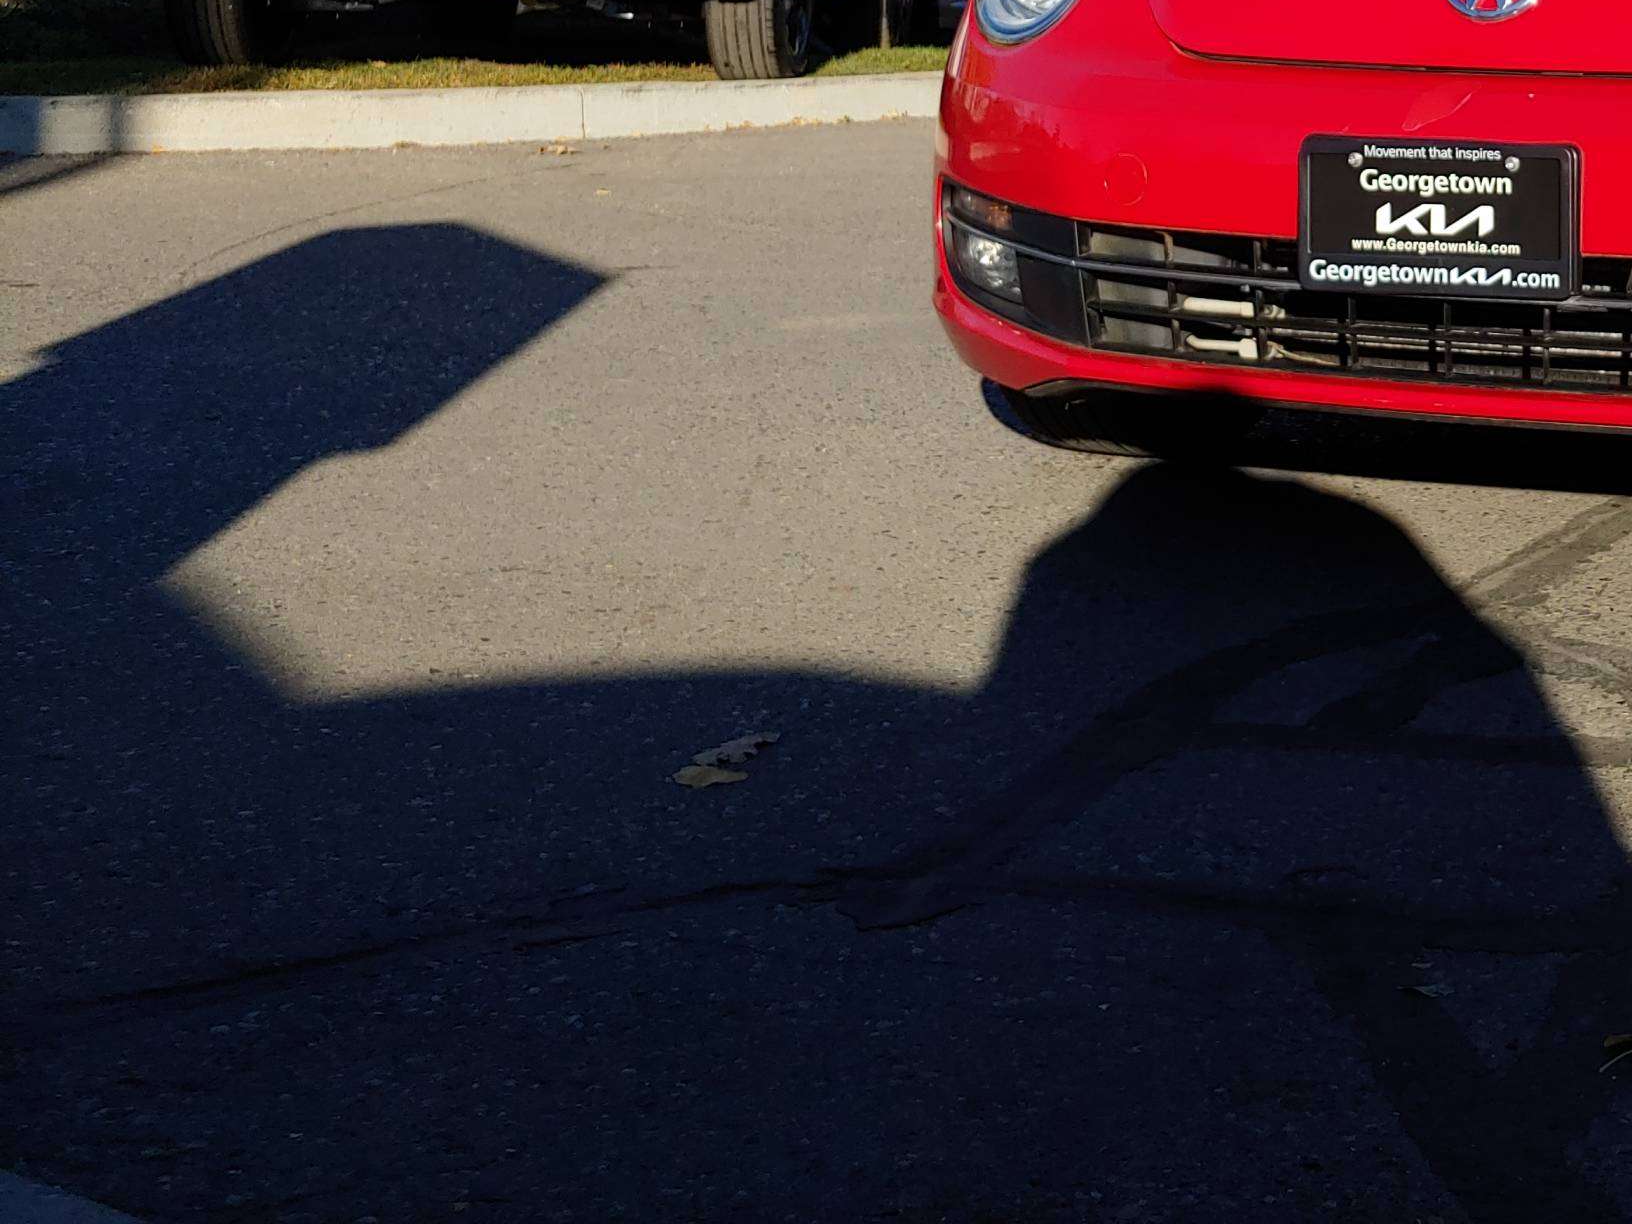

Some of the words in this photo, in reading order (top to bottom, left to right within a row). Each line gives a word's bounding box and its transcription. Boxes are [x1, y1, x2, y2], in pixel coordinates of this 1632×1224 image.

[1363, 145, 1427, 159] Movement
[1428, 147, 1453, 160] that
[1455, 147, 1501, 162] inspires
[1359, 168, 1513, 198] Georgetown
[1376, 202, 1495, 237] KIA
[1351, 237, 1521, 256] www.Georgetownkia.com
